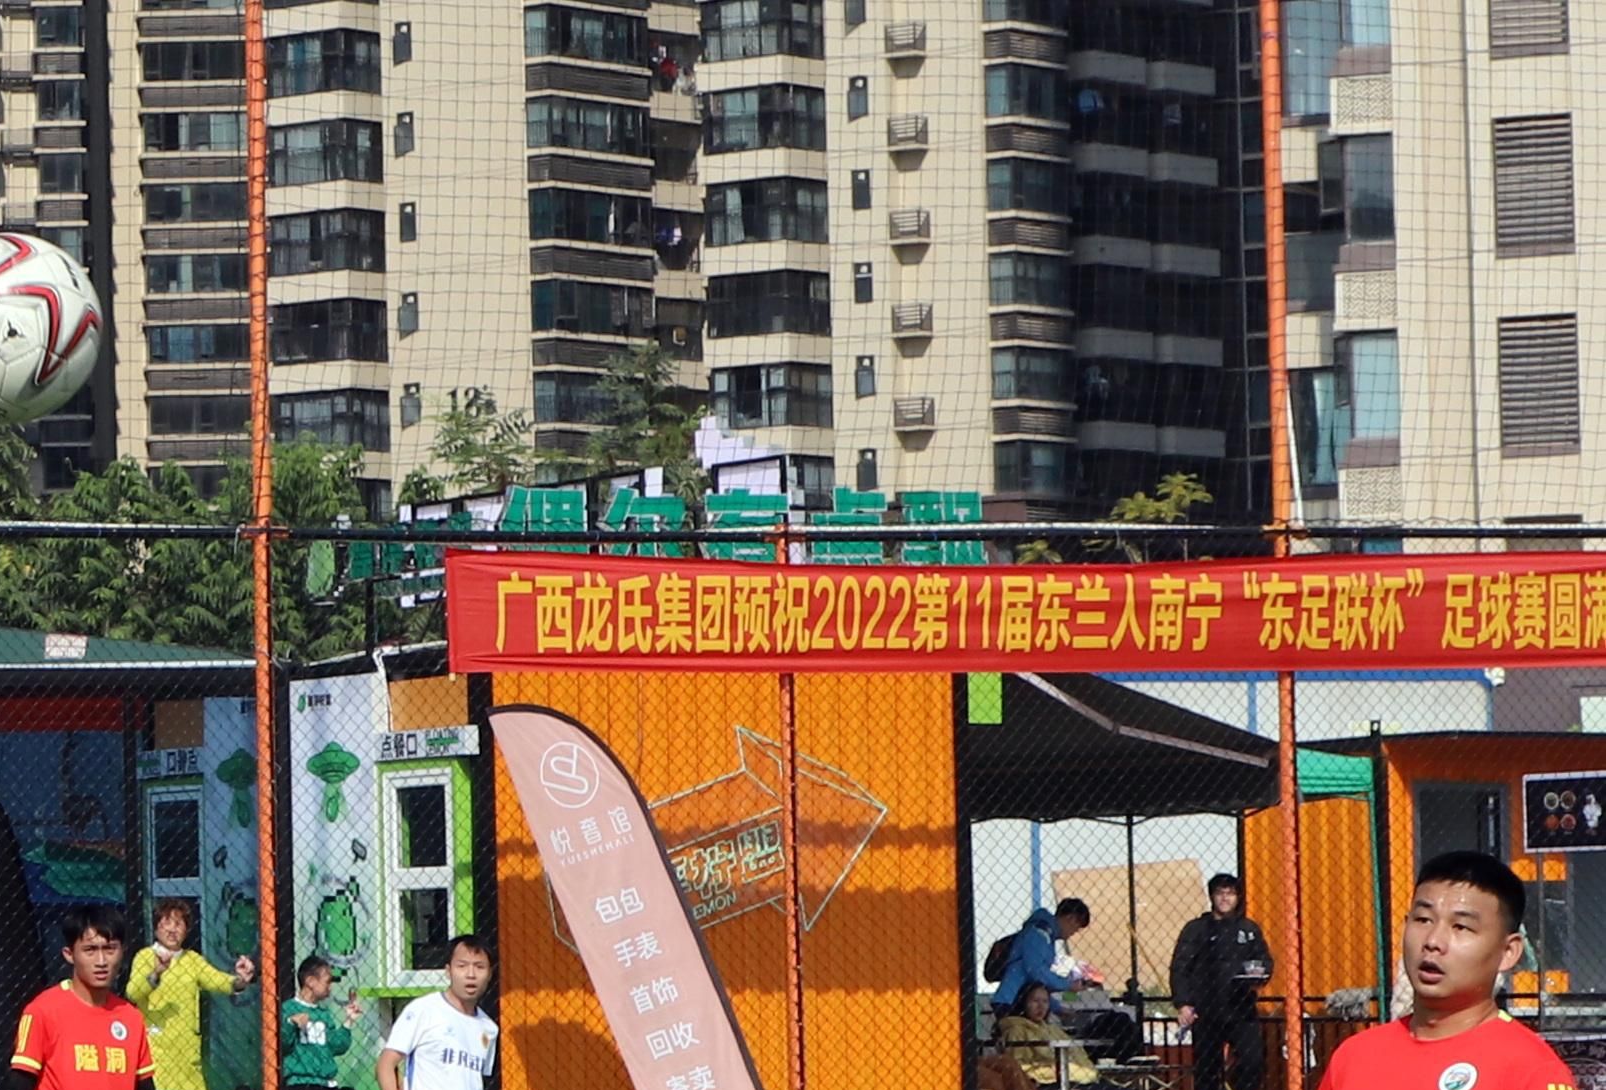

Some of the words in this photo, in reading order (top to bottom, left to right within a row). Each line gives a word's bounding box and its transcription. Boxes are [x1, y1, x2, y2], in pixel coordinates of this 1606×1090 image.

[595, 887, 645, 924] 包包
[613, 930, 663, 968] 手表
[629, 976, 679, 1015] 首饰
[645, 1020, 700, 1060] 回收
